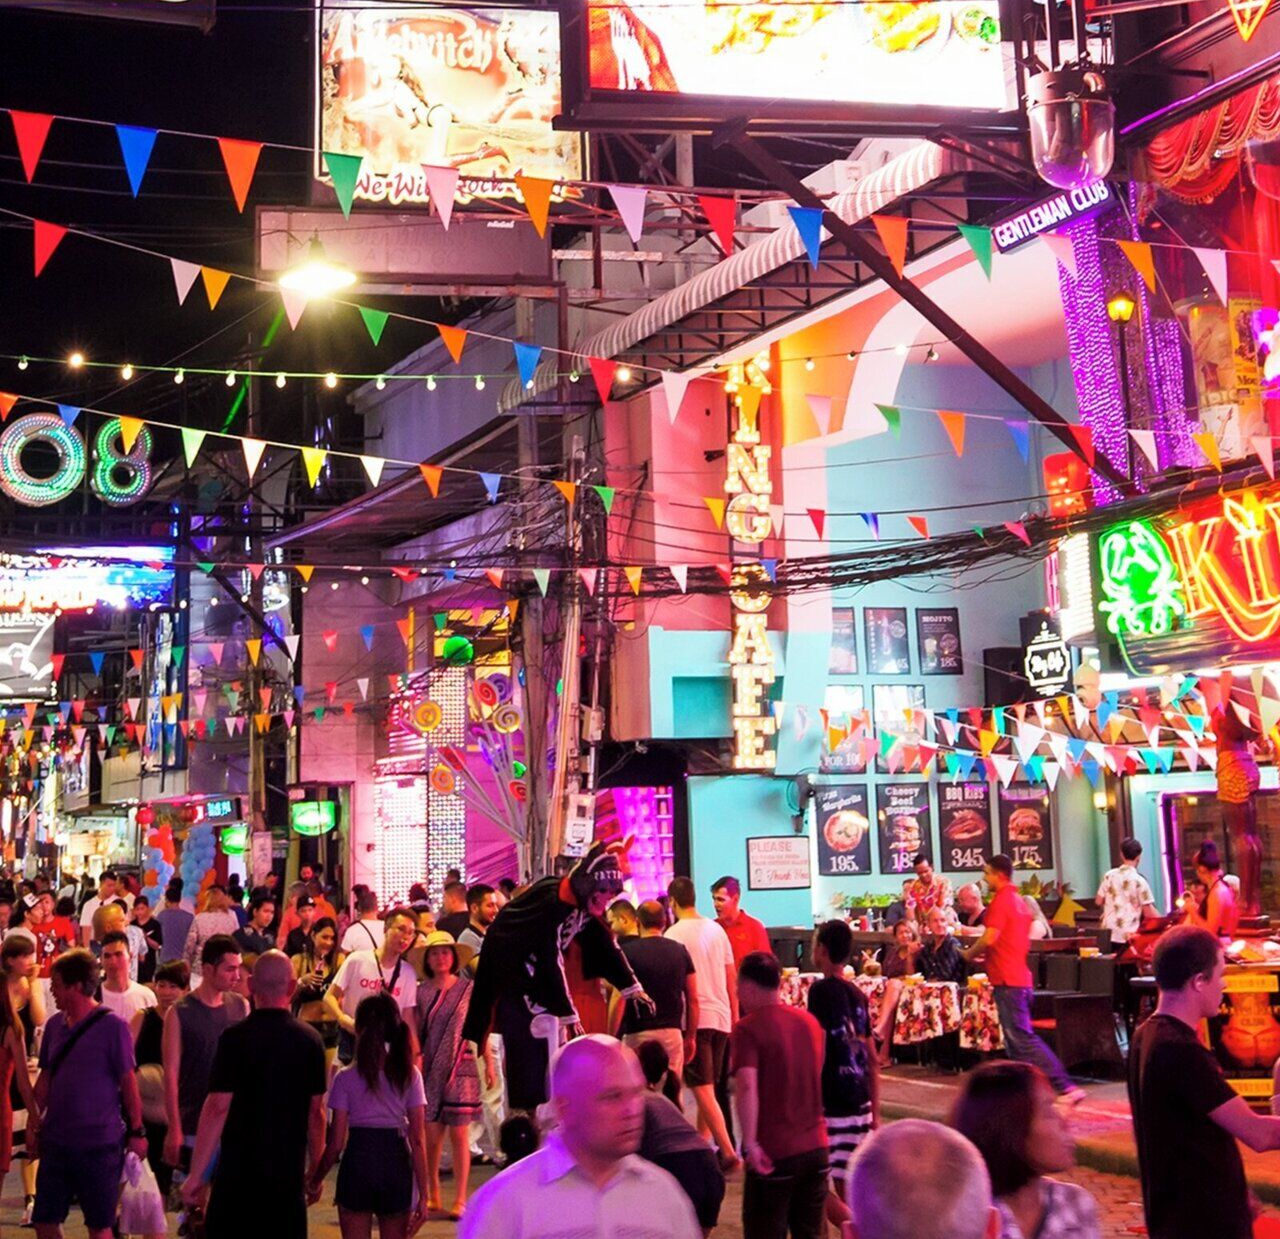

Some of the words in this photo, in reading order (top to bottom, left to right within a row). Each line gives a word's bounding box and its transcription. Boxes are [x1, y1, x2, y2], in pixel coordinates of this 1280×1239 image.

[995, 195, 1072, 247] GENTLEMAN
[1070, 179, 1109, 211] CLUB
[725, 350, 773, 543] KING
[729, 564, 776, 768] CAFE
[884, 786, 919, 797] Cheesy
[945, 787, 963, 800] BBQ
[890, 796, 914, 806] Beef
[750, 841, 792, 852] PLEASE
